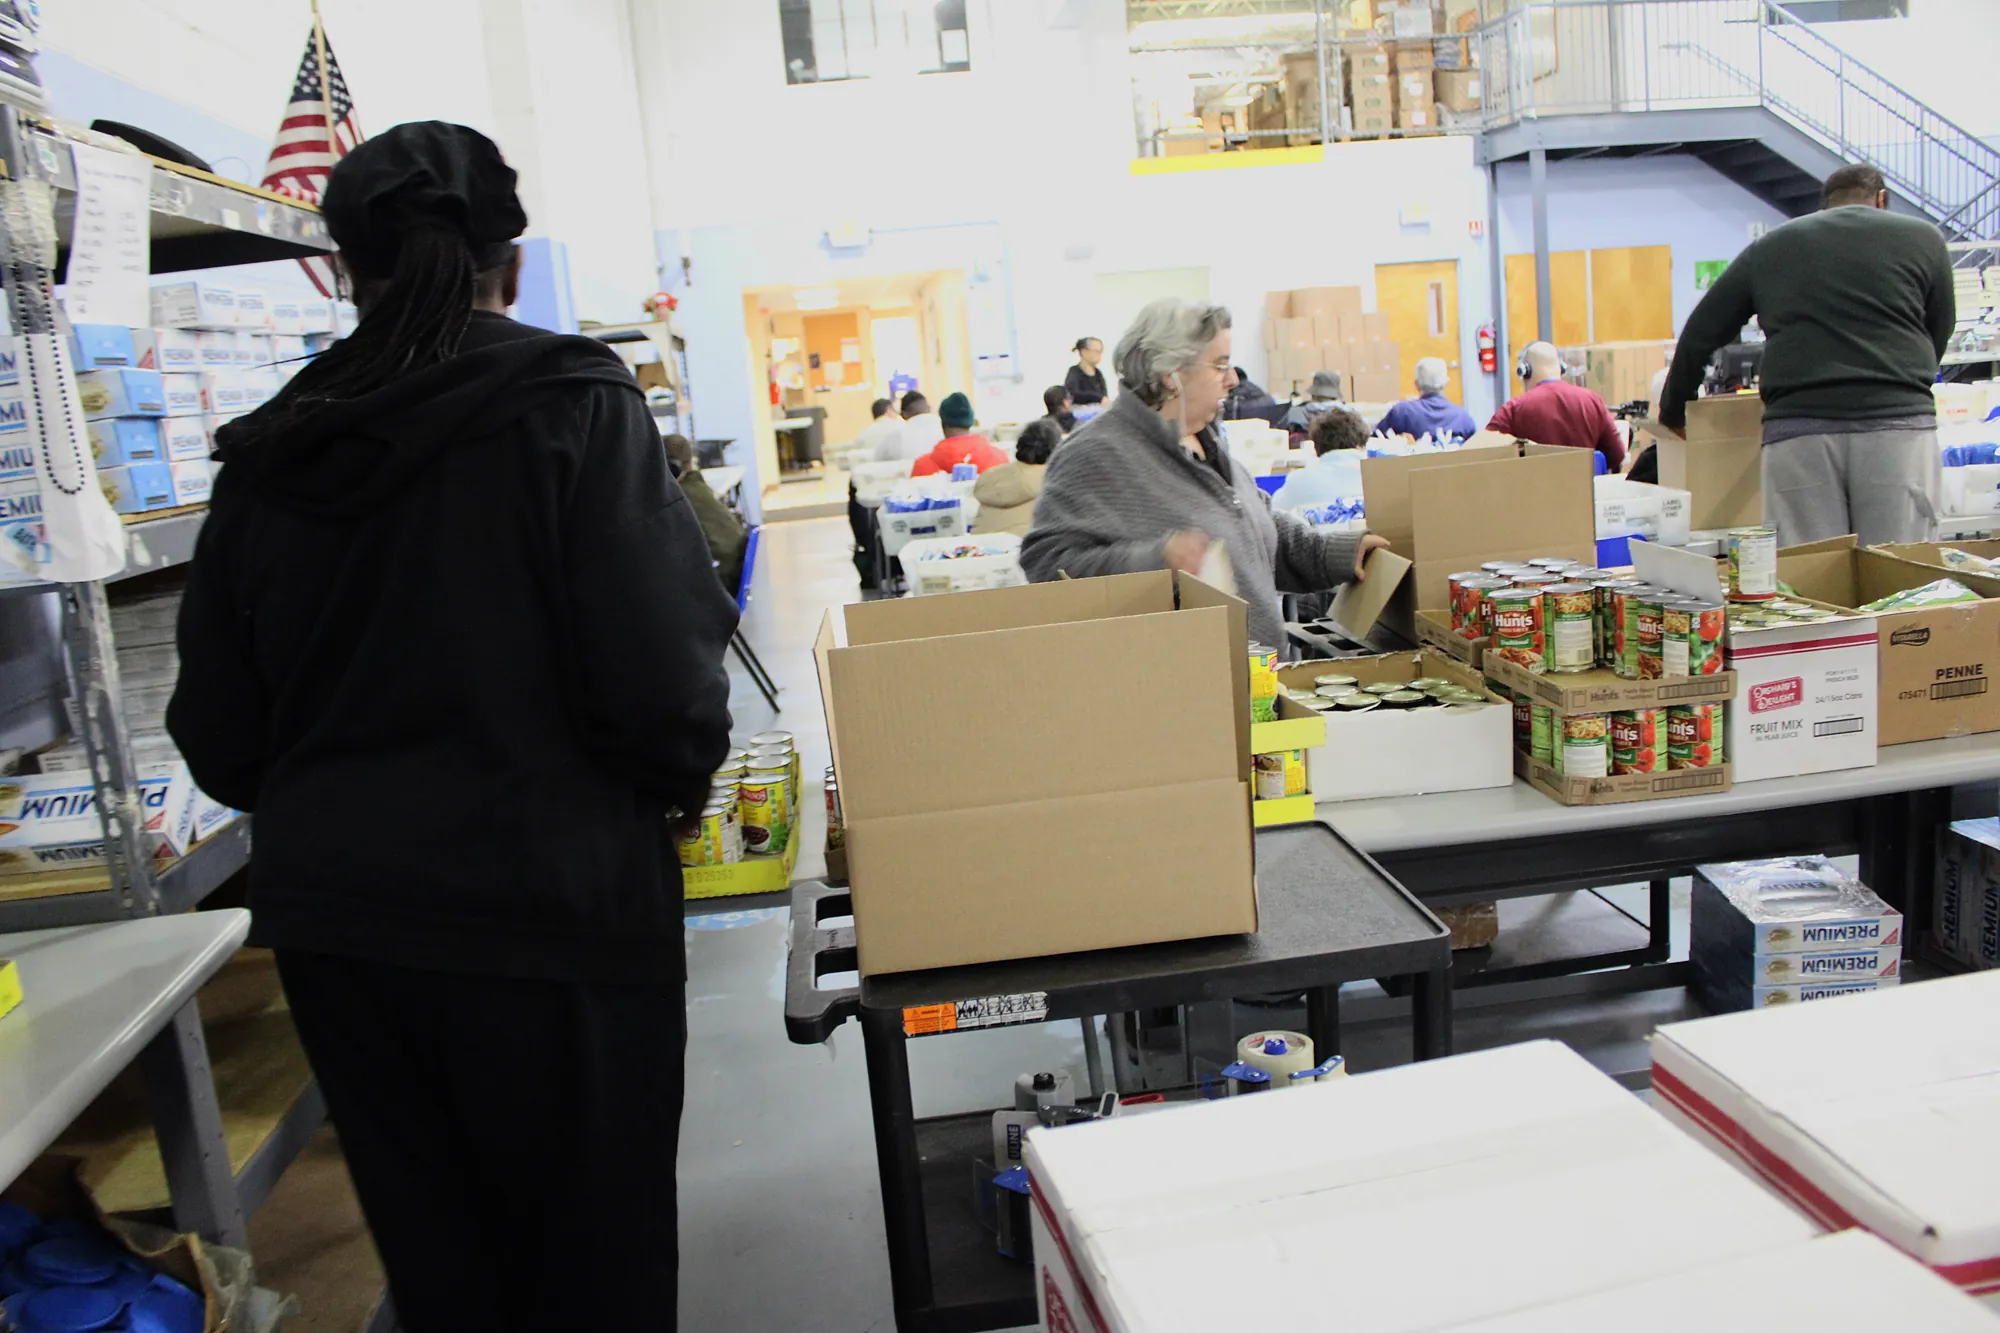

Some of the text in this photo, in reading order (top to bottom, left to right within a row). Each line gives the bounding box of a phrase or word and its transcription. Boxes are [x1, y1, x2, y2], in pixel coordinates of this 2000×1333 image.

[1495, 613, 1533, 628] Hunt's
[1638, 621, 1664, 635] unt's
[1936, 664, 1983, 680] PENNE
[1898, 689, 1927, 700] 475471
[1750, 718, 1804, 734] FRUIT MIX
[1802, 924, 1880, 942] PREMIUM
[1801, 955, 1879, 974] PREMIUM
[1008, 1124, 1020, 1159] ULINE
